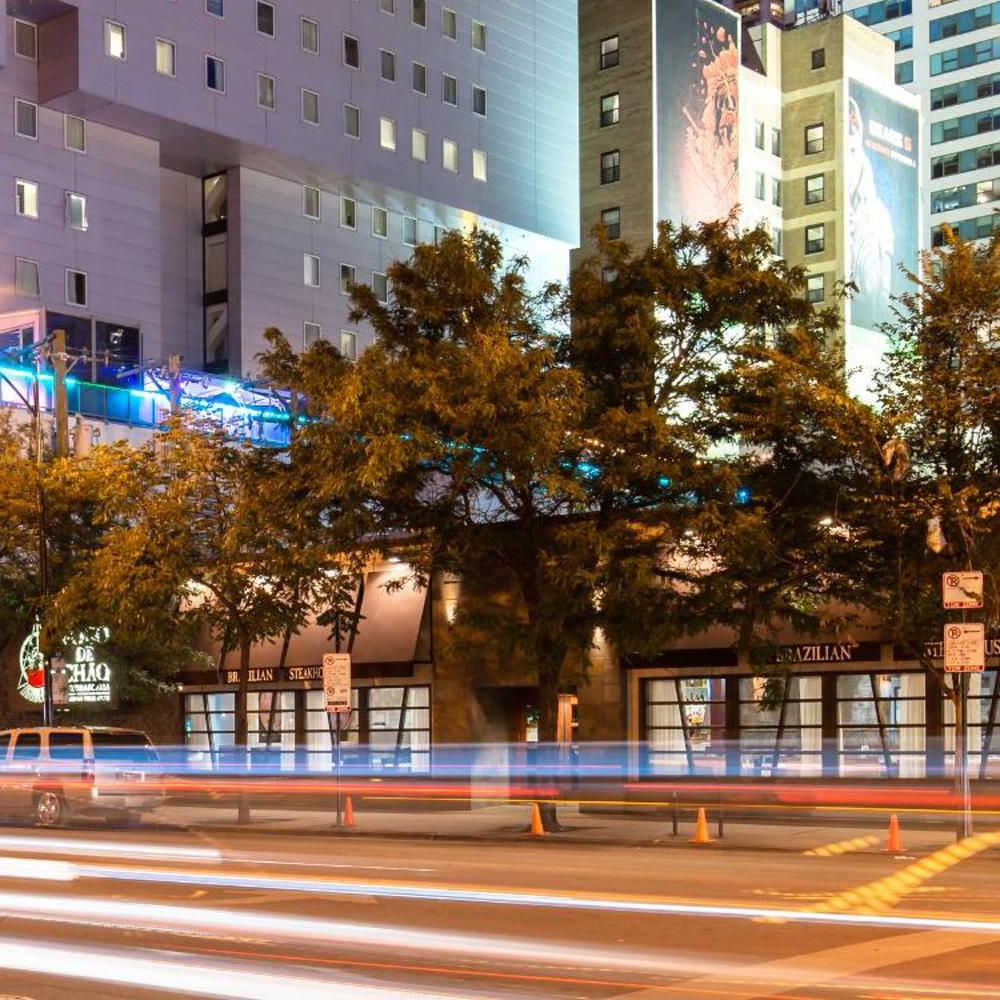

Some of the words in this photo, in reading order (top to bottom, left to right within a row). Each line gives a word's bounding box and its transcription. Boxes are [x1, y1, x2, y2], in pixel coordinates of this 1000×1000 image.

[776, 645, 851, 662] RAZILIAN
[227, 668, 273, 683] BRILIAN
[289, 666, 324, 680] STEAKHO
